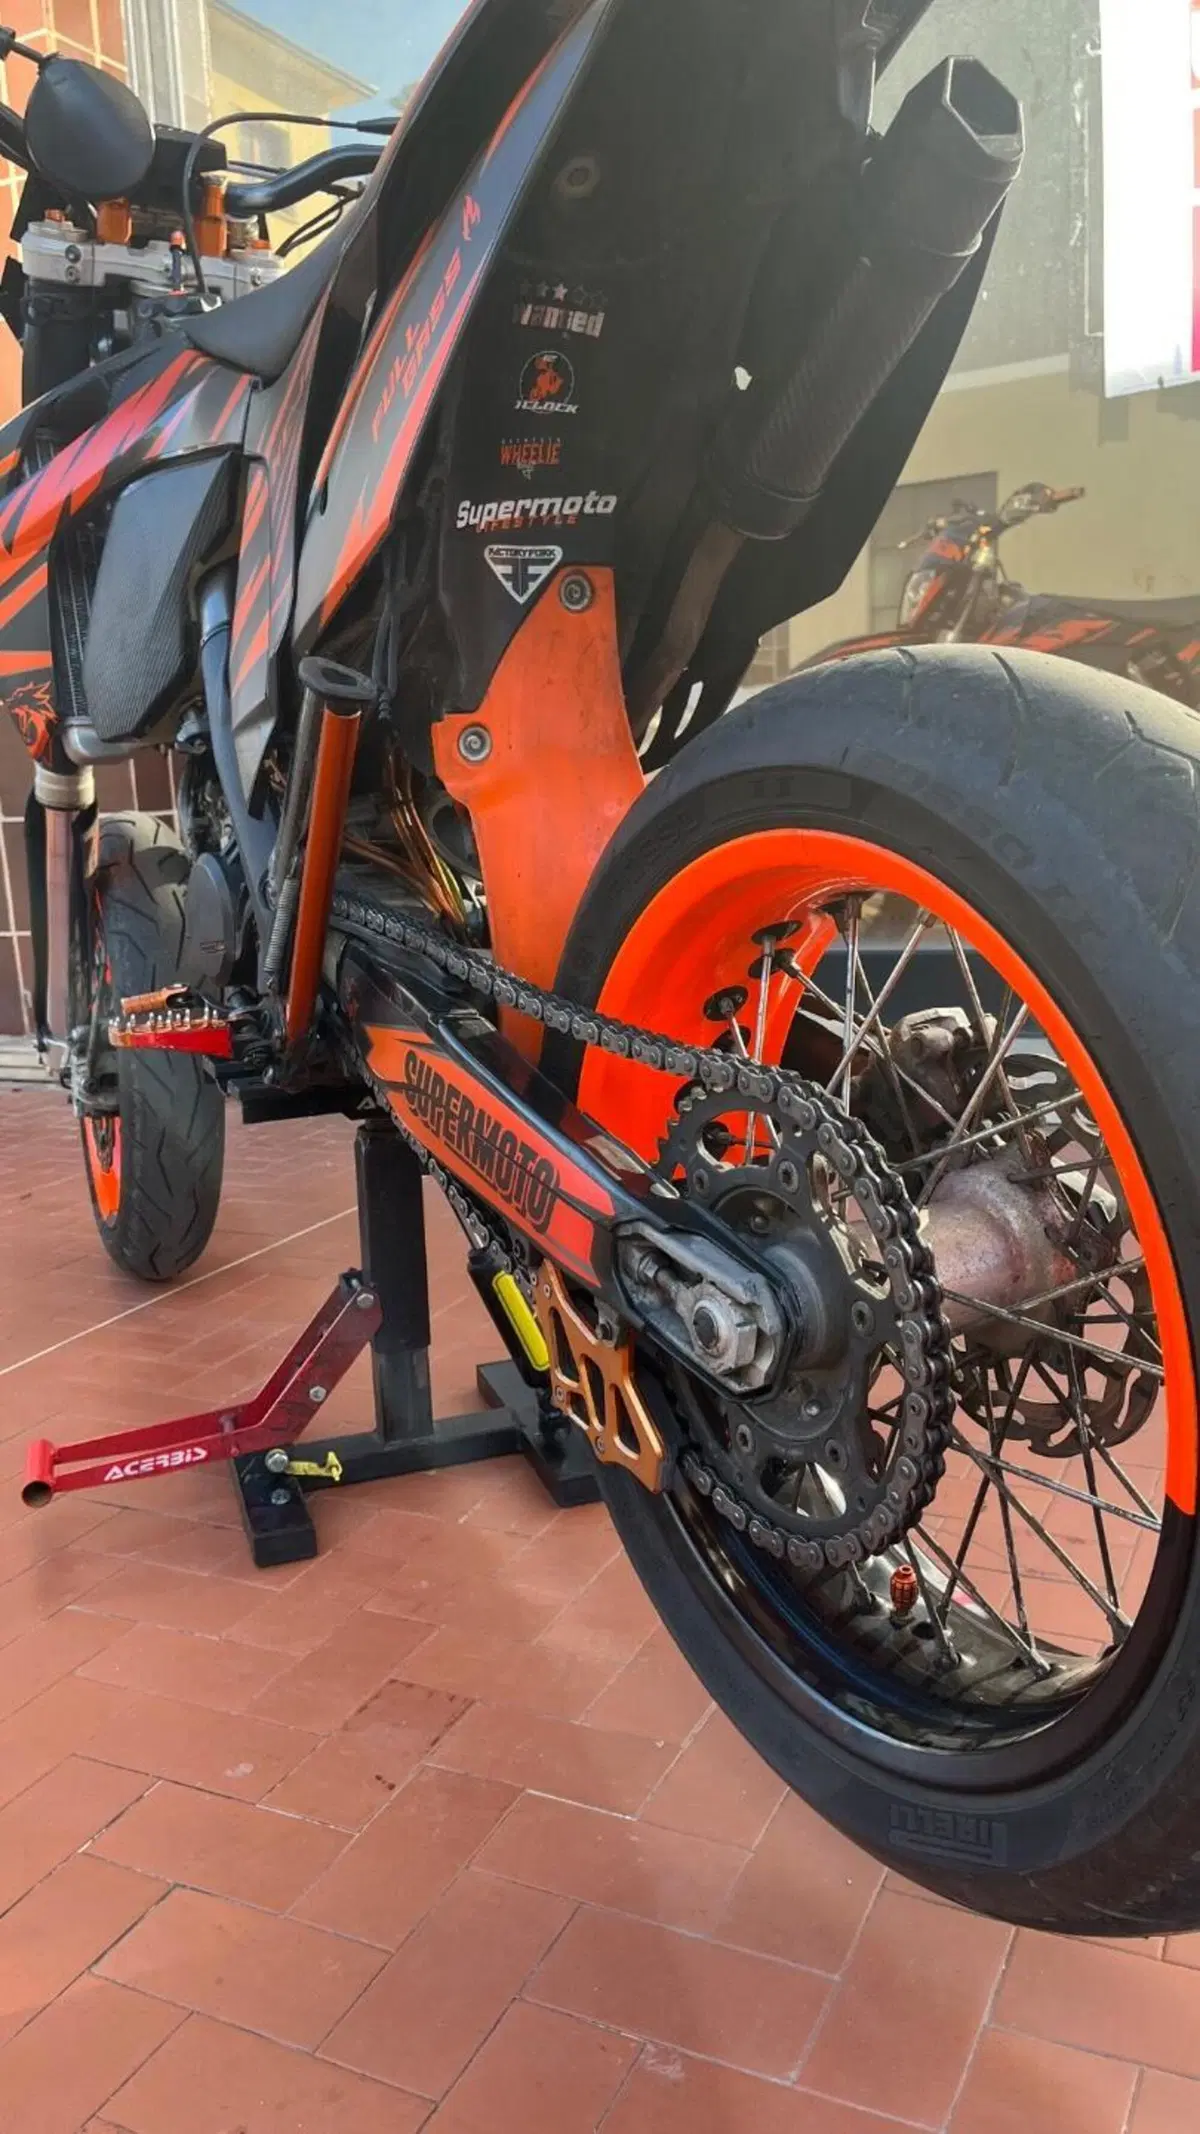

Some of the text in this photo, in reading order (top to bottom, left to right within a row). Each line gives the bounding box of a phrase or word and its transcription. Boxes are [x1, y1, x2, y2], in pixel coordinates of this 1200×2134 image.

[500, 442, 562, 465] WHEELIE
[455, 490, 618, 530] Supermoto
[404, 1049, 560, 1235] SUPERMOTO
[887, 1803, 1008, 1868] PIRELLI
